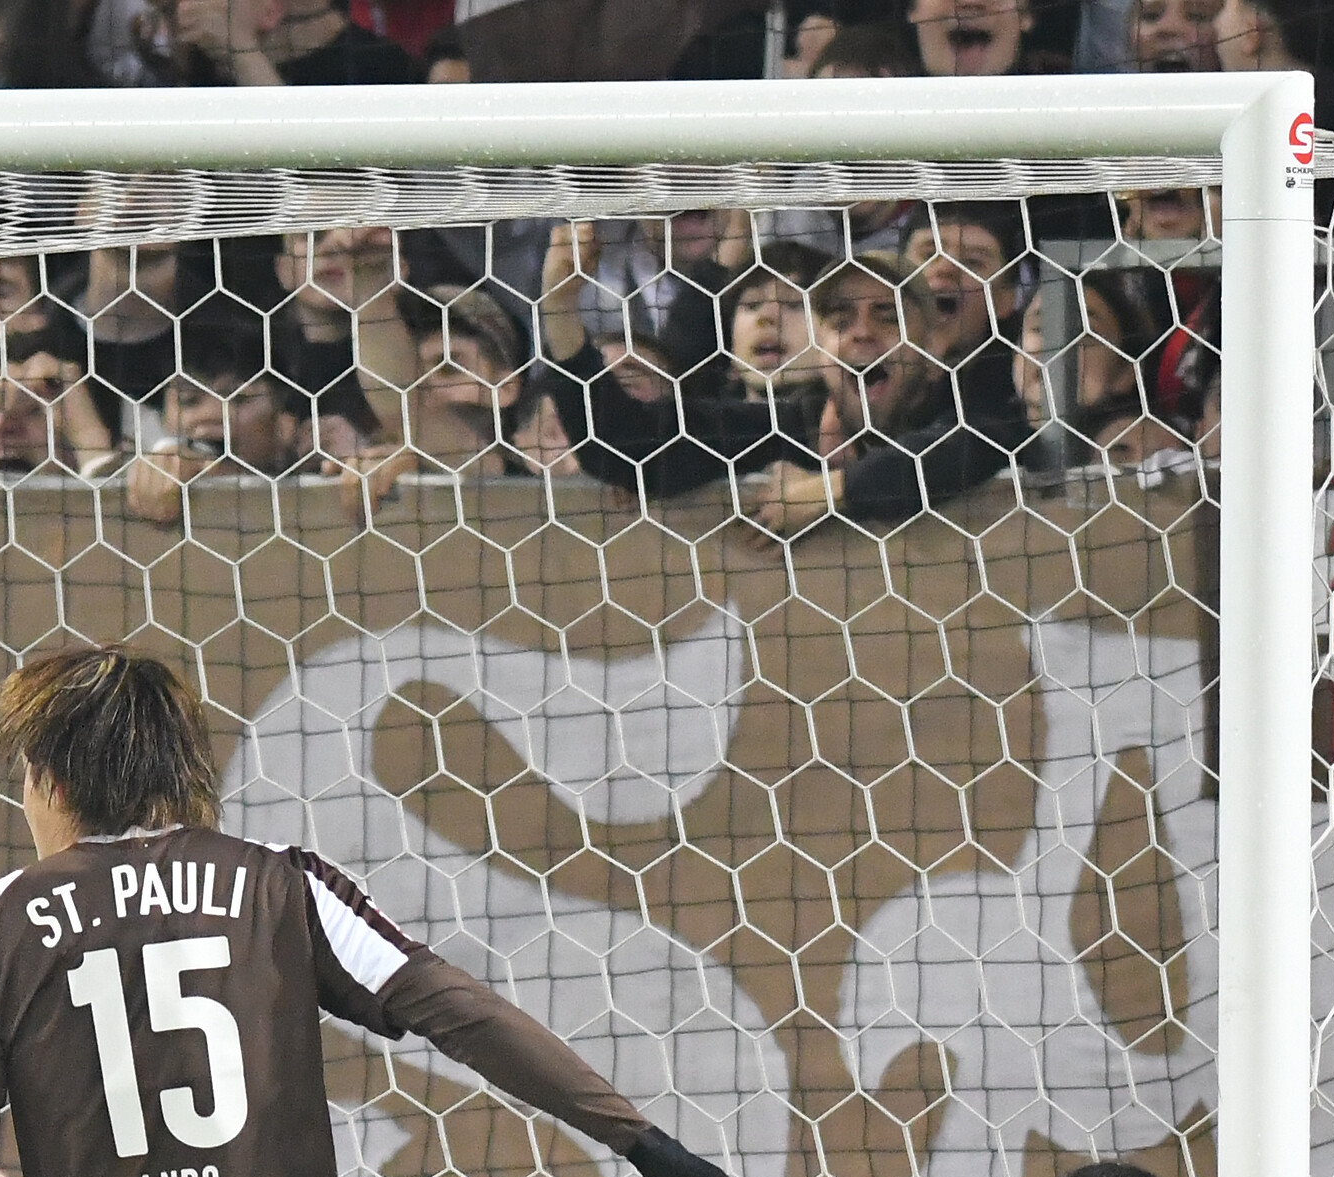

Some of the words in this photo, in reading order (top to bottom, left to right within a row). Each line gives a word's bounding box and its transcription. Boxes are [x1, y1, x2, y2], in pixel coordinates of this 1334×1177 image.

[26, 883, 101, 949] ST.
[111, 861, 247, 918] PAULI
[68, 935, 248, 1158] 15
